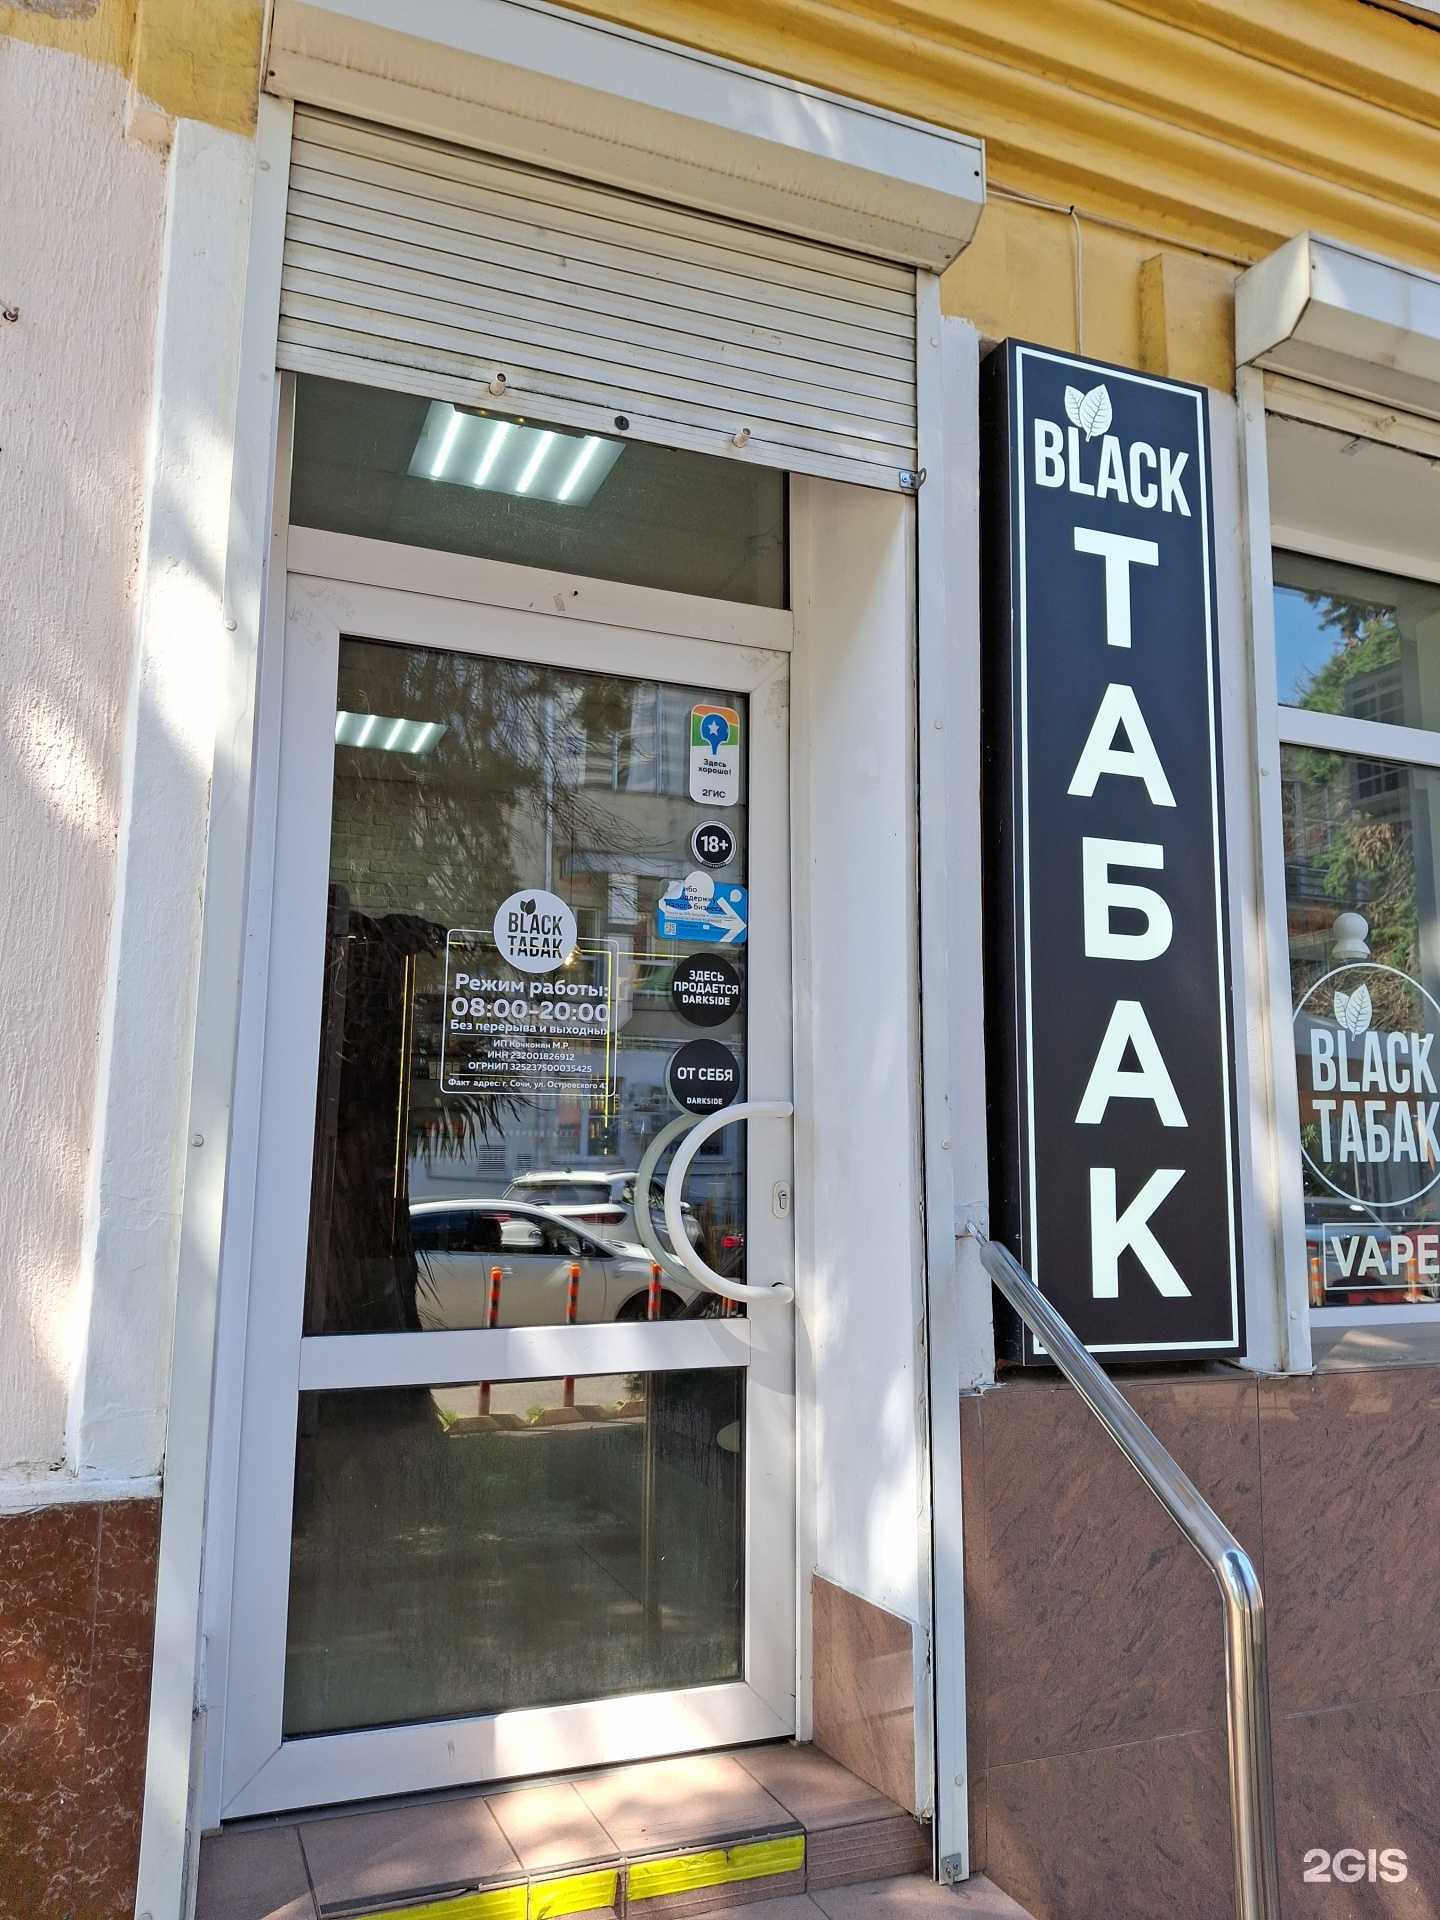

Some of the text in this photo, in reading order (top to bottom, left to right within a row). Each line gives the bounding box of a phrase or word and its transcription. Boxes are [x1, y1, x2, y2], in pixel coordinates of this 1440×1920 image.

[1034, 417, 1192, 518] BLACK
[703, 758, 727, 768] Здесь
[698, 766, 732, 776] хорошо!
[702, 788, 726, 799] 2ГИС
[700, 835, 729, 853] 18+
[1066, 526, 1192, 1301] ТАБАК
[508, 911, 563, 936] BLACK
[507, 935, 563, 959] ТАБАК
[688, 970, 725, 981] ЗДЕСЬ
[455, 973, 609, 997] Режим работы:
[673, 981, 739, 995] ПРОДАЕТСЯ
[682, 994, 731, 1006] DARKSIDE
[451, 997, 609, 1022] 08:00-20:00
[450, 1020, 472, 1031] Без
[475, 1021, 537, 1034] перерыва
[539, 1025, 547, 1033] и
[493, 1039, 507, 1048] ИП
[487, 1051, 509, 1059] ИНН
[1310, 1028, 1438, 1094] BLACK
[468, 1061, 508, 1070] ОГРНИП
[677, 1067, 733, 1082] ОТ СЕБЯ
[686, 1097, 723, 1105] DARKSIDE
[1312, 1099, 1440, 1163] ТАБАК
[1331, 1234, 1440, 1277] VAPE
